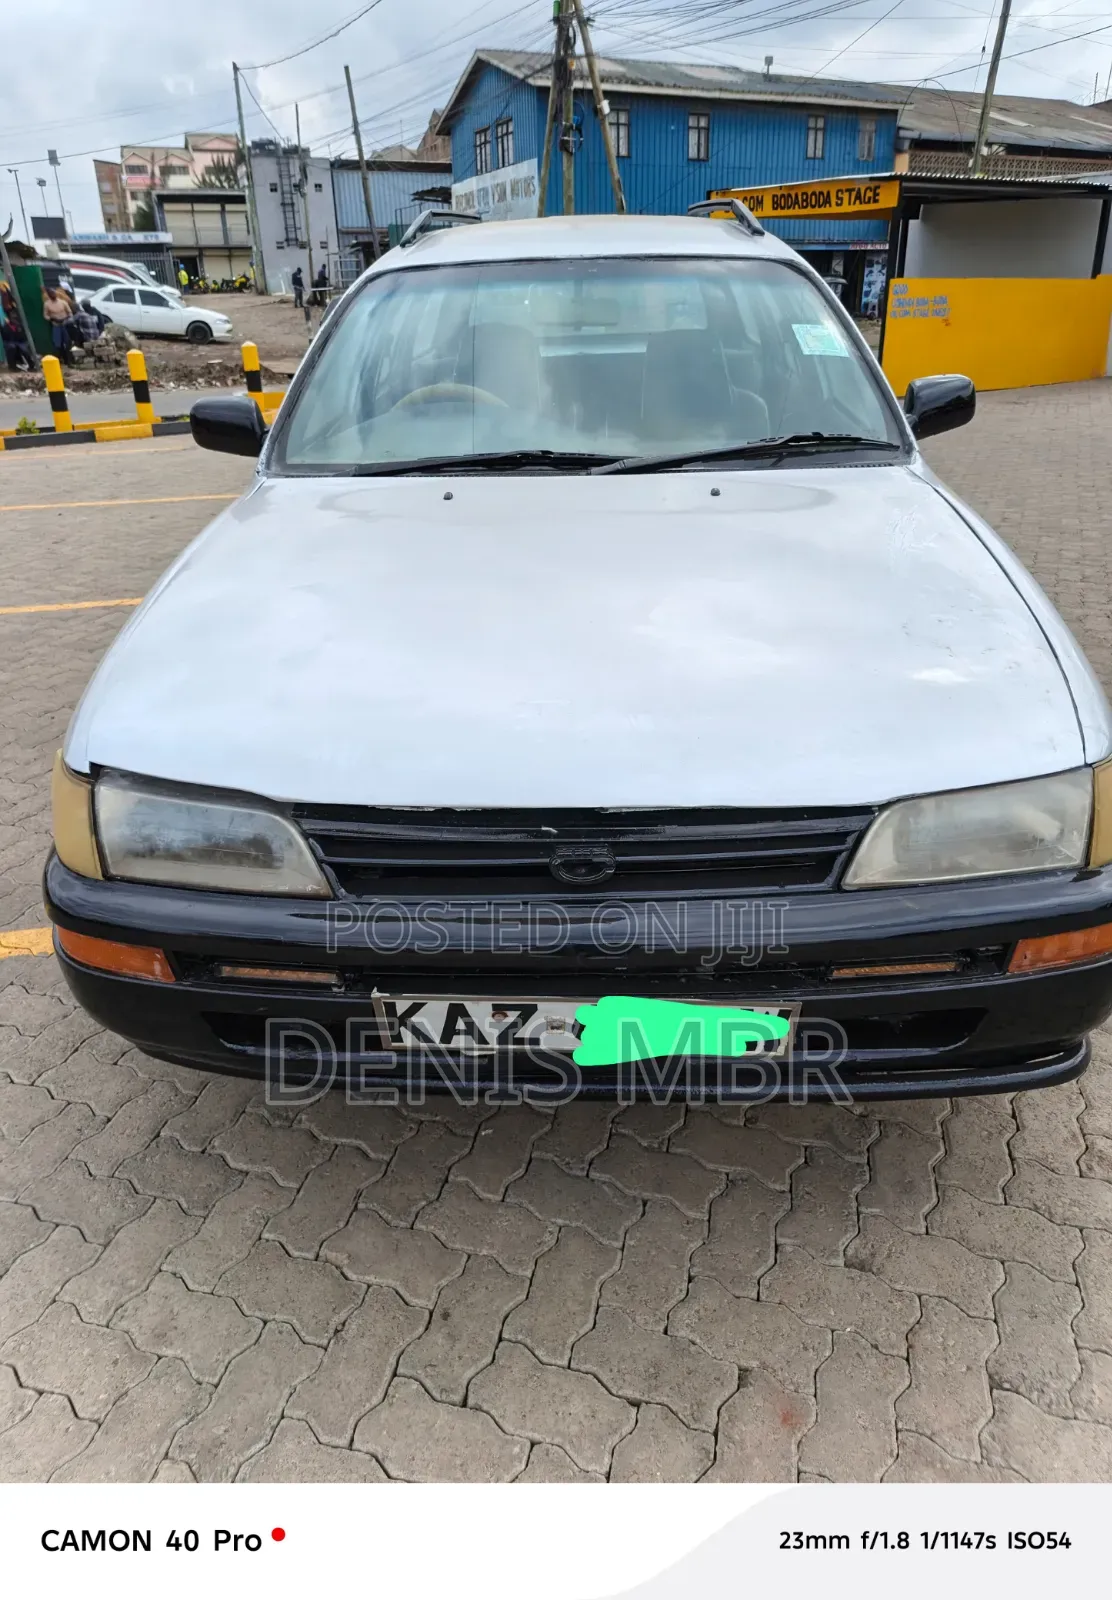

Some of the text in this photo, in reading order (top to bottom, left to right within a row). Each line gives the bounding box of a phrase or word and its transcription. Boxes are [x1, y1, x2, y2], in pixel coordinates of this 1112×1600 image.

[771, 190, 832, 211] BODABODA
[835, 185, 881, 207] STAGE
[382, 1002, 540, 1046] KAZ
